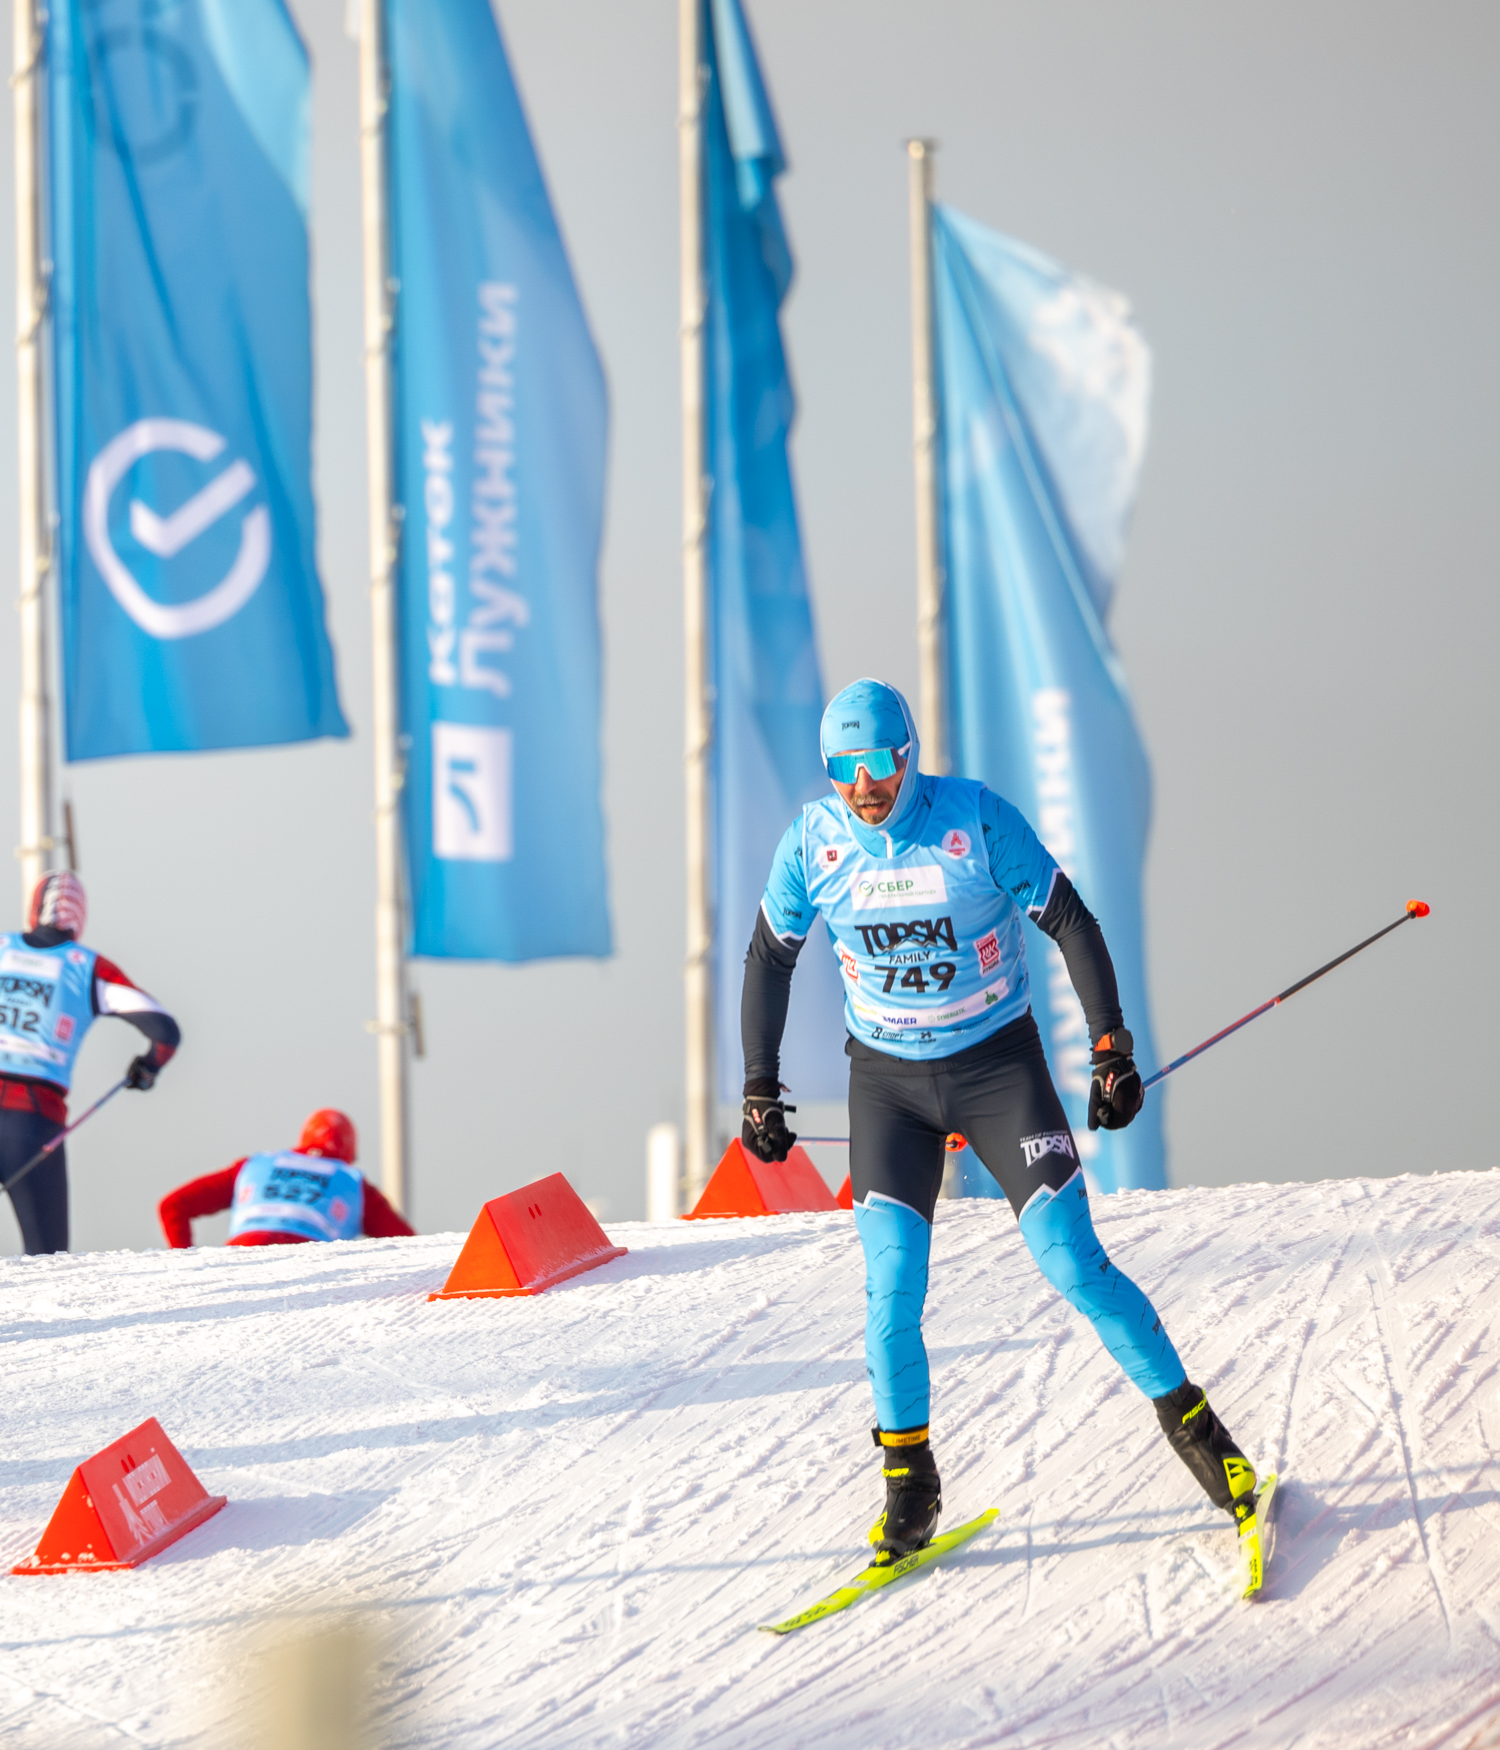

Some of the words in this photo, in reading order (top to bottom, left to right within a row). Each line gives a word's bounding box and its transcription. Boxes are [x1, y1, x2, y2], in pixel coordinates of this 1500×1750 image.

[458, 281, 531, 700] Лужники
[877, 880, 914, 893] СБЕР
[854, 916, 958, 958] TOPSKI
[889, 951, 931, 965] FAMILY
[874, 962, 956, 994] 749
[888, 1016, 917, 1026] MAER
[936, 1007, 966, 1022] SYNERGETIC
[1020, 1134, 1074, 1168] TOPSKI
[263, 1185, 323, 1205] 527
[892, 1434, 921, 1444] LIMETIME
[893, 1554, 919, 1576] FISCHER
